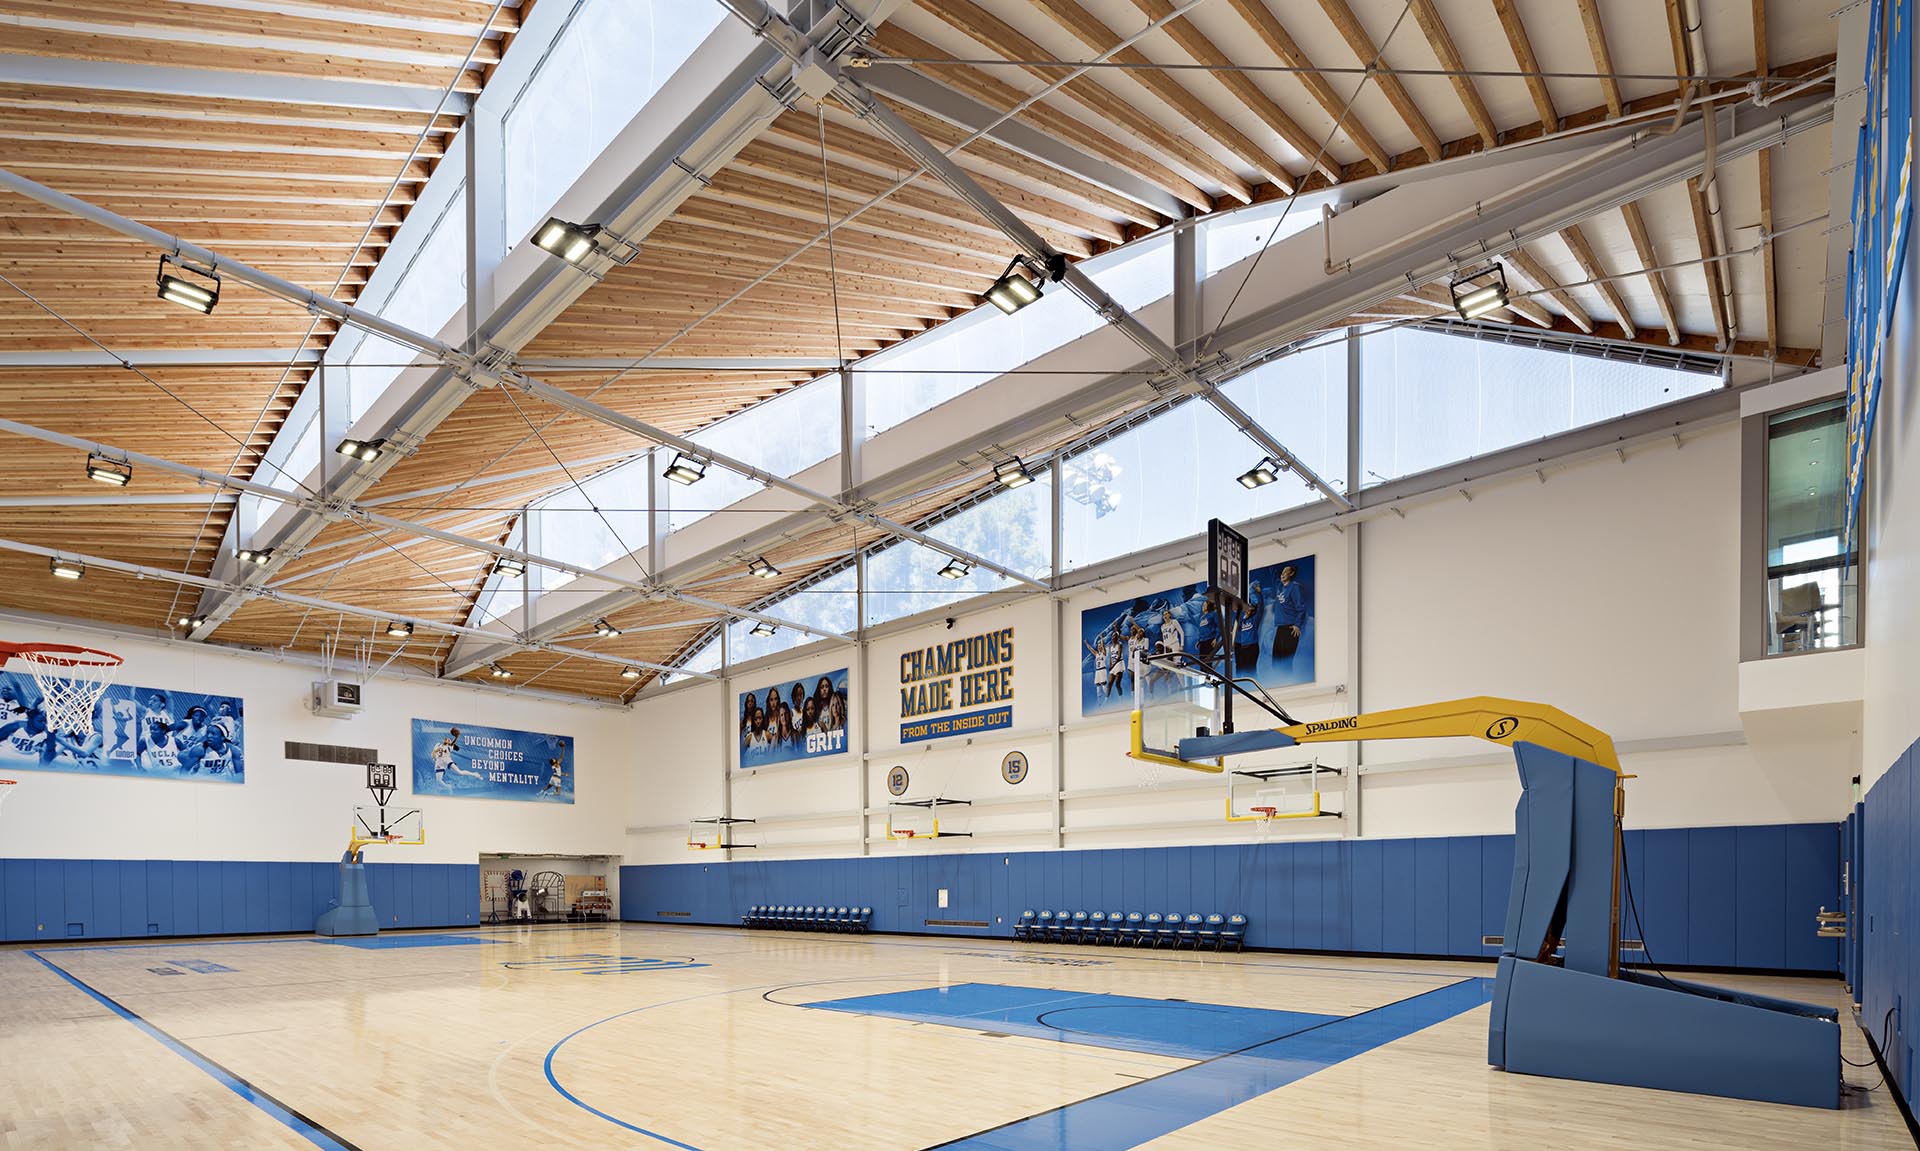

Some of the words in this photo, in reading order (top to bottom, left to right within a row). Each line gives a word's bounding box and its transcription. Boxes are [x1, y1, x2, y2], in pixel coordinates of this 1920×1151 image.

[900, 626, 1015, 684] CHAMPIONS
[900, 678, 954, 718] MADE
[960, 665, 1015, 707] HERE
[902, 724, 928, 738] FROM
[930, 721, 950, 734] THE
[952, 715, 985, 731] INSIDE
[987, 711, 1009, 725] OUT
[1305, 716, 1358, 735] SPALDING
[464, 736, 513, 750] UNCOMMON
[806, 729, 844, 753] GRIT
[151, 750, 177, 758] UCLA
[488, 750, 524, 762] CHOICES
[471, 758, 505, 772] BEYOND
[1008, 760, 1021, 774] 15
[489, 772, 540, 785] MENTALITY
[892, 774, 903, 787] 12
